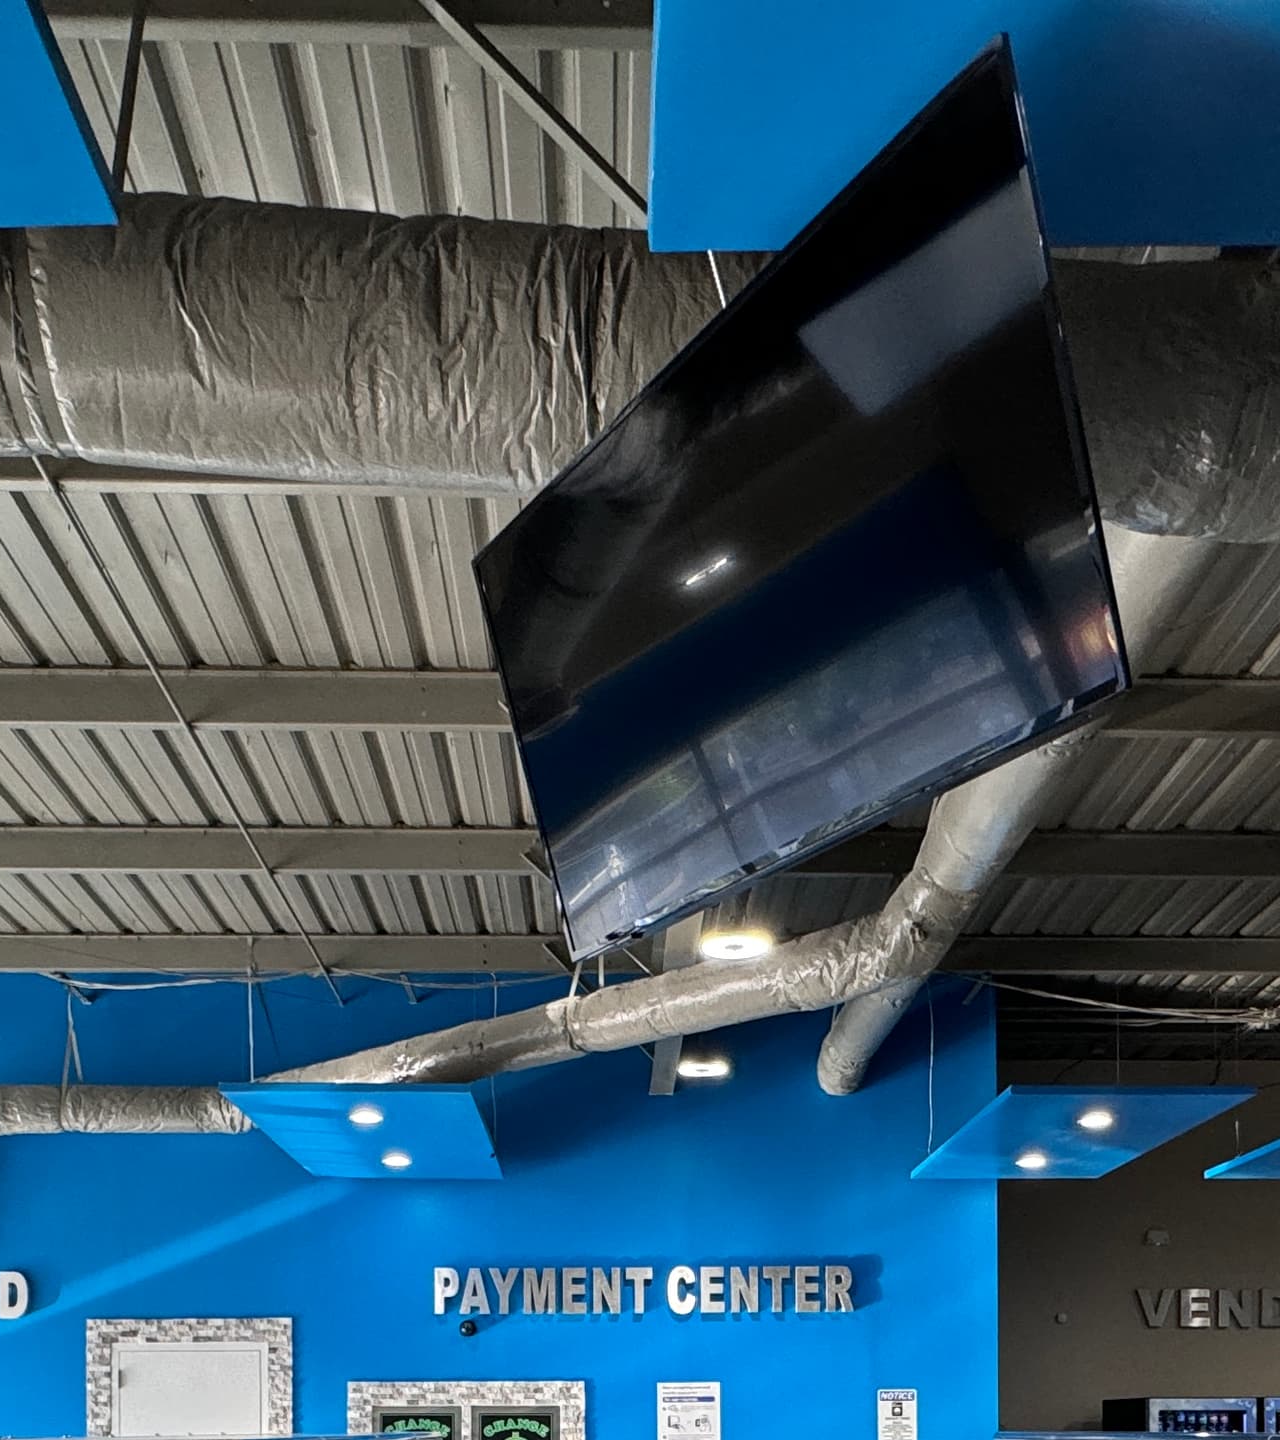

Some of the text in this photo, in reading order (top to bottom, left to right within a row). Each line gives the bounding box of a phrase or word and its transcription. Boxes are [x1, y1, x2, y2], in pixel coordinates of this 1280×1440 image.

[433, 1265, 856, 1315] PAYMENT CENTER
[880, 1391, 914, 1400] NOTICE
[483, 1418, 550, 1438] CHANGE
